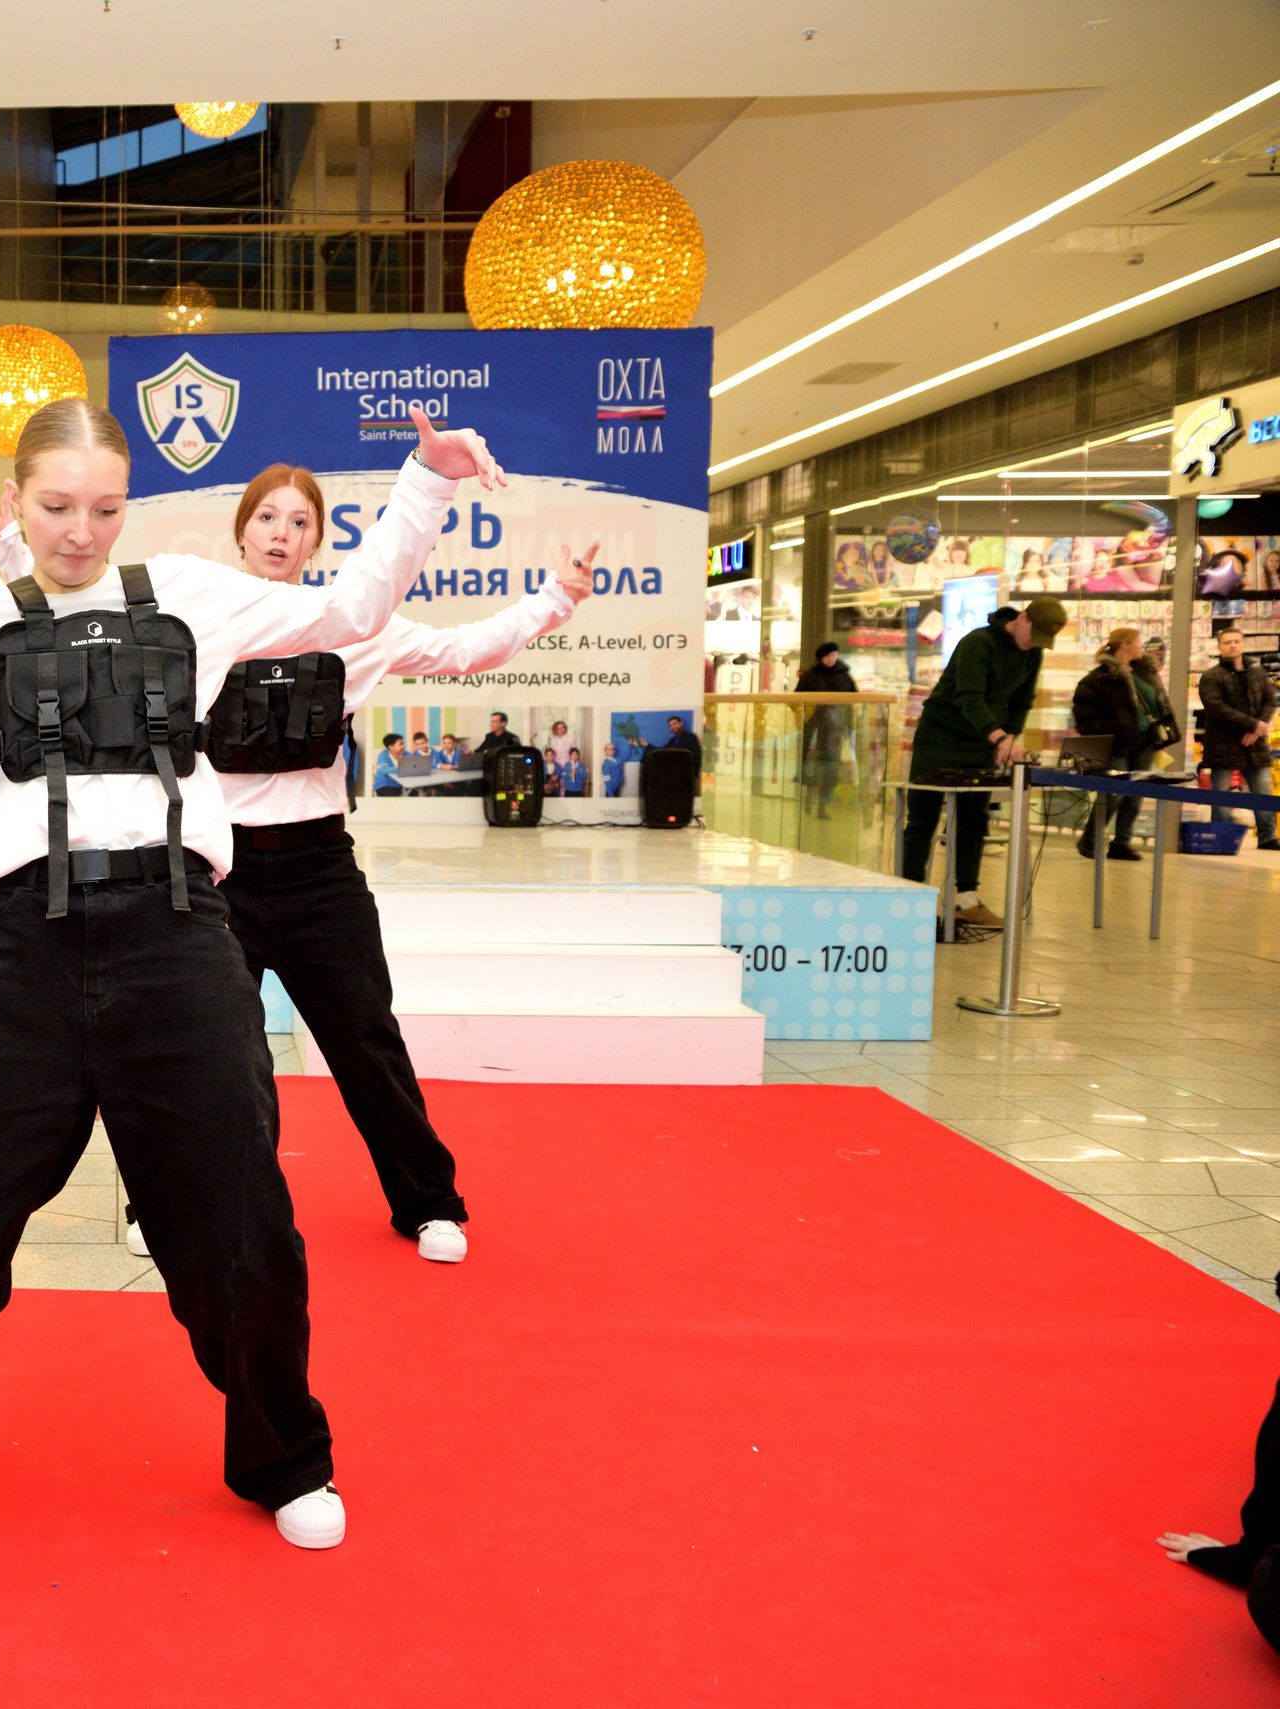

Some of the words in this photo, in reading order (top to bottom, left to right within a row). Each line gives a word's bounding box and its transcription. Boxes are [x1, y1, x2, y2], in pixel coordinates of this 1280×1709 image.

[317, 363, 490, 391] International
[598, 357, 666, 402] ОХТА
[175, 384, 203, 409] IS
[360, 393, 449, 419] School
[182, 440, 199, 448] SPb
[360, 429, 387, 441] Saint
[389, 429, 420, 441] Peter
[597, 426, 664, 455] МОЛЛ
[578, 634, 647, 652] A-Level,
[653, 633, 688, 649] ОГЭ
[422, 672, 573, 688] Международная
[579, 671, 632, 686] среда
[821, 945, 888, 973] 17:00
